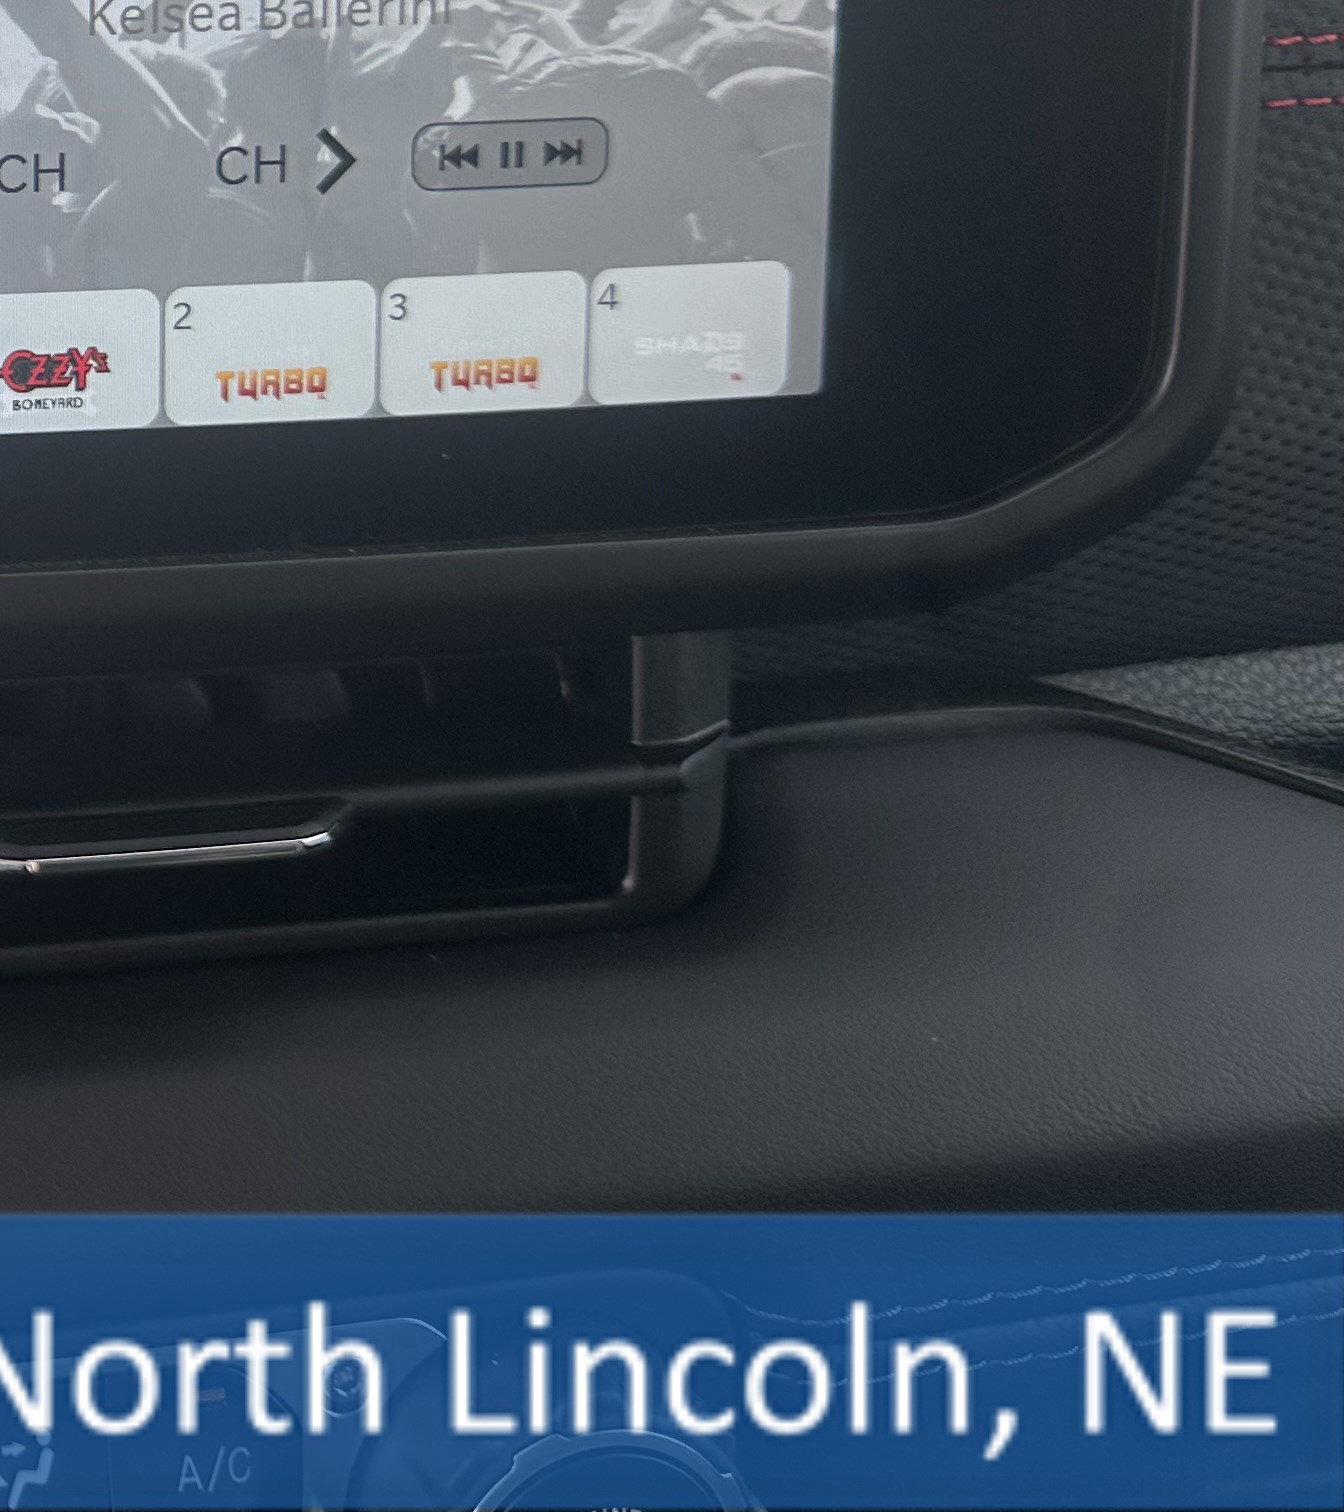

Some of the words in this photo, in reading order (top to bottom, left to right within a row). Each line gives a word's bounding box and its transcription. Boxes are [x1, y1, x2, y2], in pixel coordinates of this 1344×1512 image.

[216, 143, 287, 186] CH
[388, 293, 408, 321] 3
[596, 282, 619, 311] 4
[173, 301, 193, 330] 2
[215, 366, 329, 403] TURBO
[428, 356, 538, 393] TURBO
[177, 1445, 252, 1492] A/C
